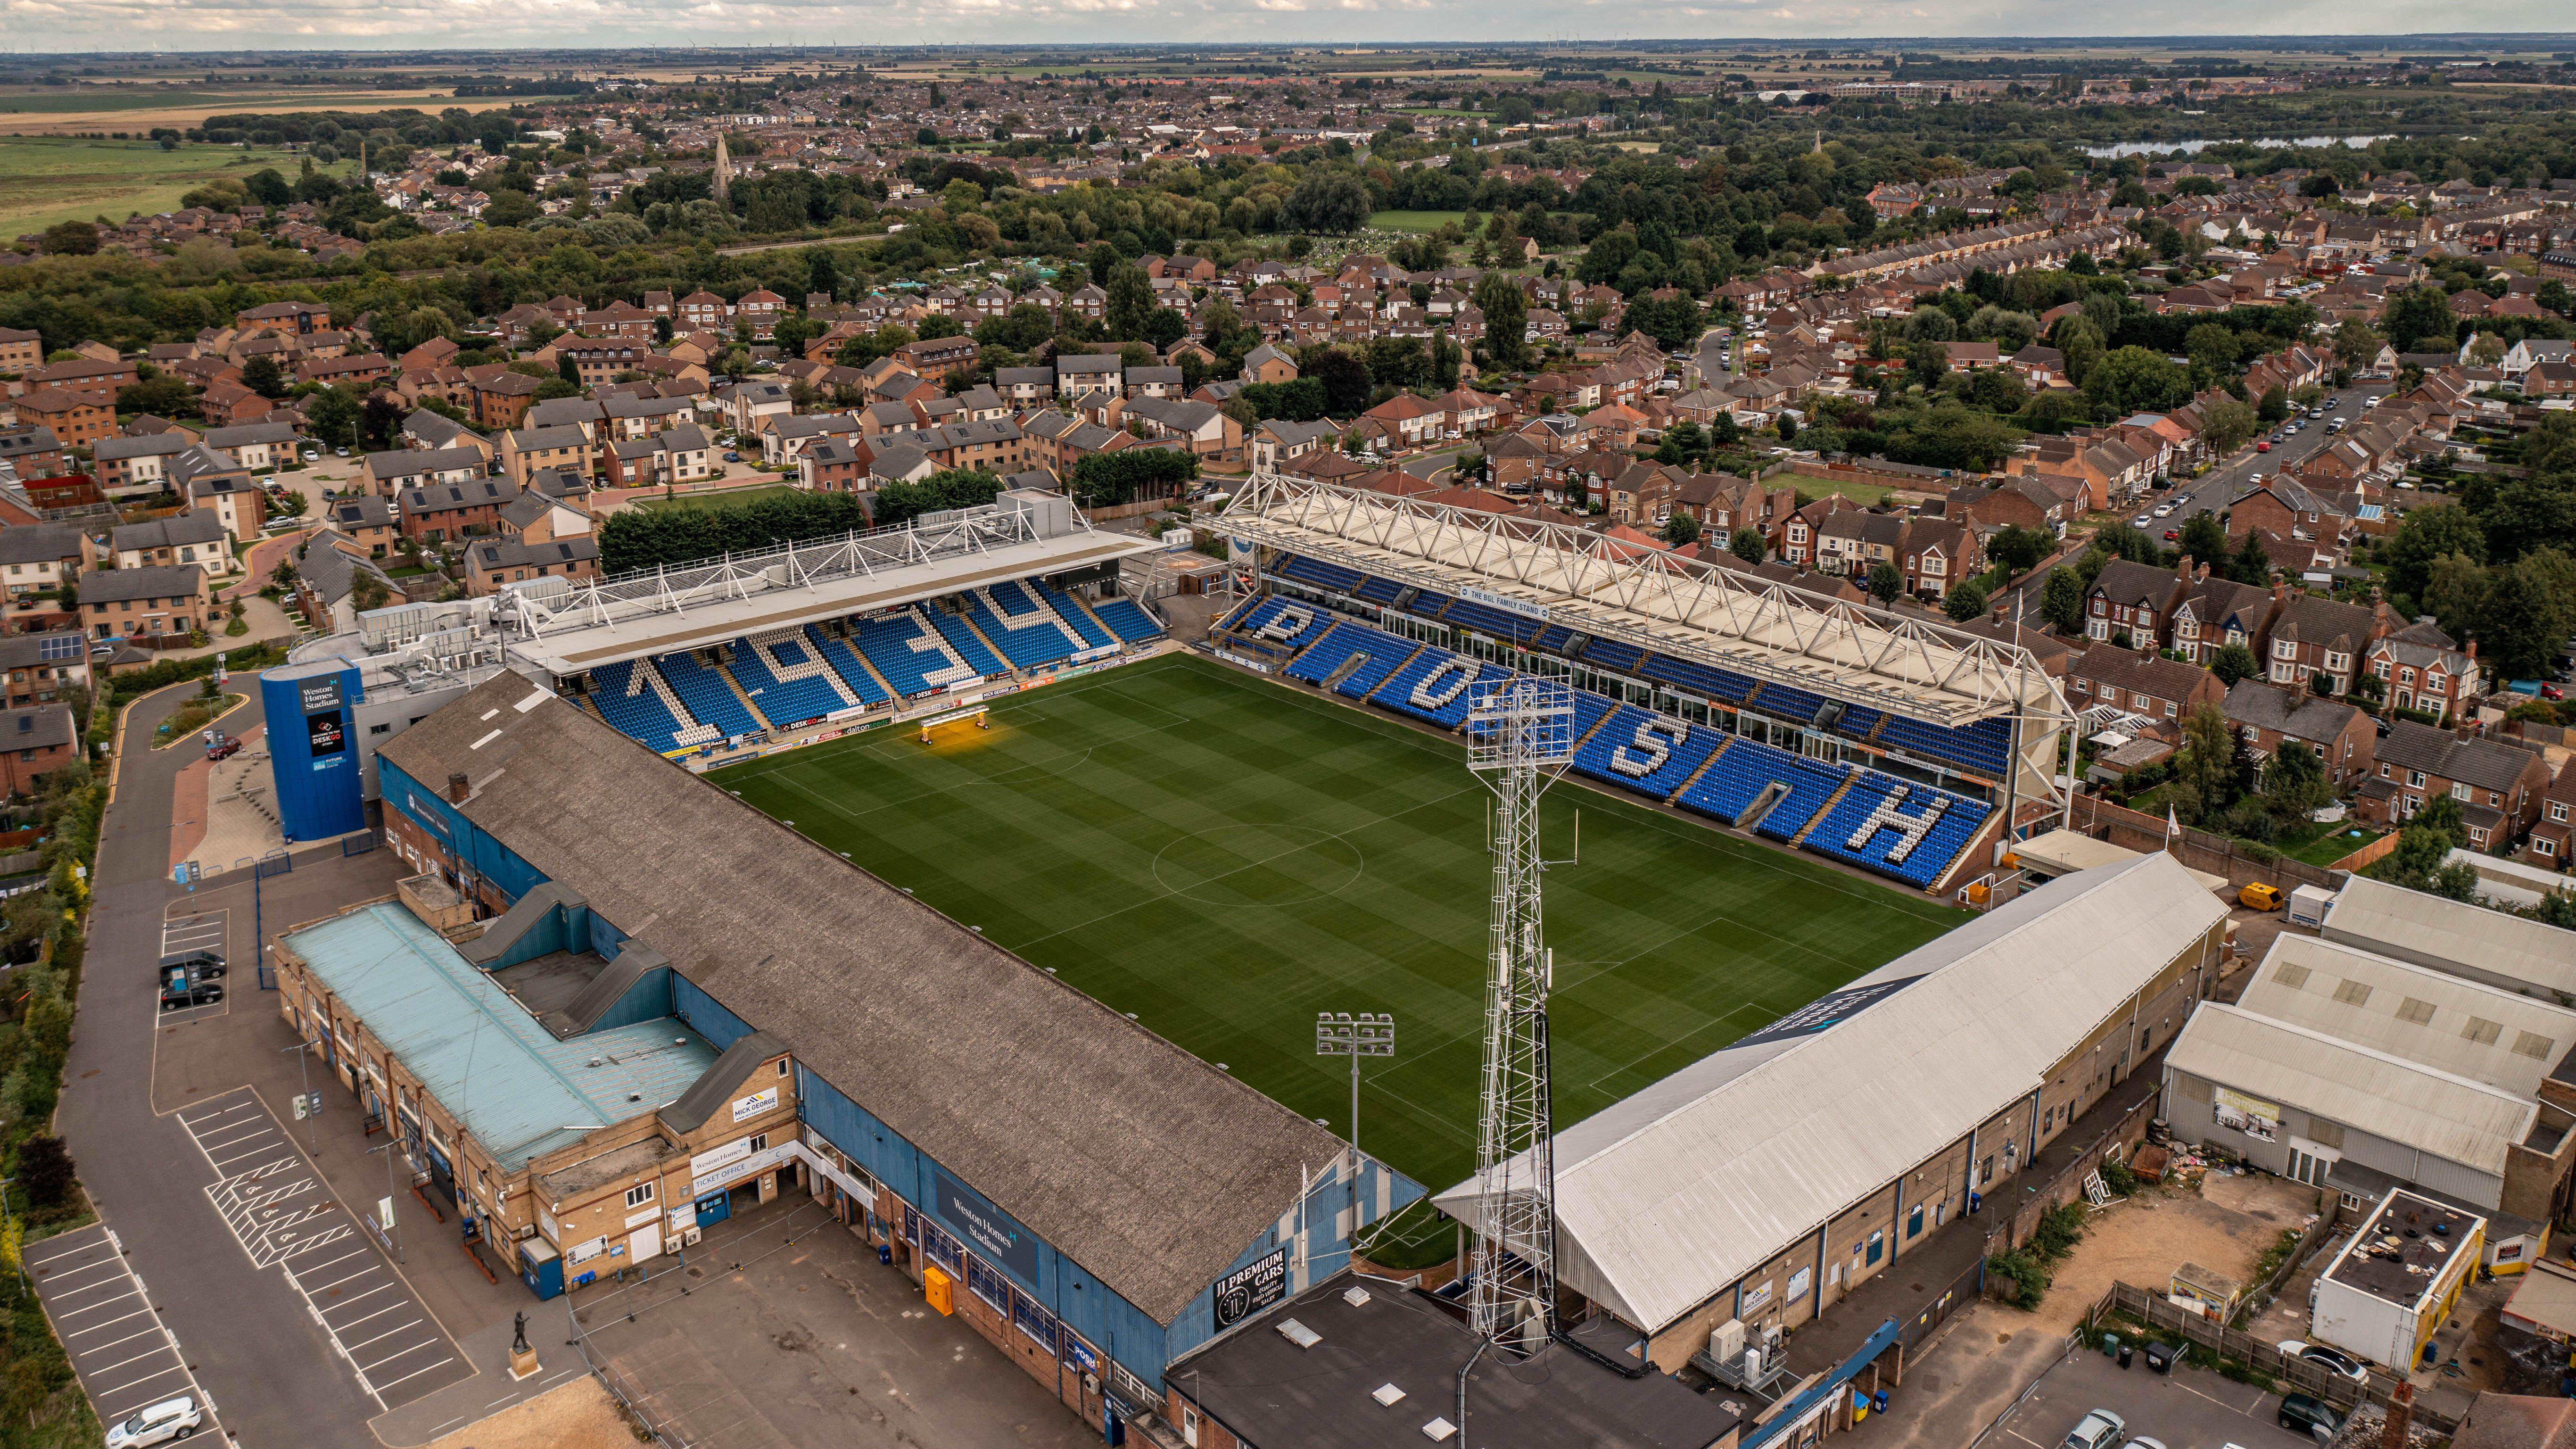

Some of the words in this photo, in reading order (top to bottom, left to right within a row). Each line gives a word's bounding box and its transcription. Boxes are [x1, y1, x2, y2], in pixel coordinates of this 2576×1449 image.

[1472, 591, 1482, 599] THE
[1484, 594, 1494, 603] BGL
[1497, 597, 1517, 609] FAMILY
[1519, 604, 1538, 614] STAND
[1134, 652, 1152, 660] HOWARD
[304, 687, 332, 696] Weston
[305, 693, 333, 703] Homes
[994, 687, 1009, 696] GEORGE
[306, 699, 339, 710] Stadium
[847, 719, 888, 734] daltonseeds
[313, 734, 341, 745] DESKGO
[1908, 757, 1929, 769] Cantwell
[1930, 764, 1942, 772] Suite
[735, 1106, 751, 1117] MICK
[751, 1097, 776, 1110] GEORGE
[2225, 1093, 2277, 1118] Hampton
[696, 1158, 719, 1169] Weston
[720, 1149, 743, 1160] Homes
[696, 1173, 719, 1187] TICKET
[721, 1163, 745, 1177] OFFICE
[954, 1197, 982, 1227] Weston
[983, 1218, 1011, 1248] Homes
[969, 1224, 1002, 1257] Stadium
[1217, 1280, 1225, 1297] JJ
[1229, 1250, 1283, 1289] PREMIUM
[1255, 1262, 1284, 1286] CARS
[1259, 1279, 1278, 1293] QUALITY
[1253, 1292, 1264, 1303] USED
[1261, 1294, 1275, 1306] SALES
[1745, 1300, 1755, 1310] MICK
[1755, 1289, 1771, 1303] GEORGE
[1075, 1346, 1095, 1367] POSH
